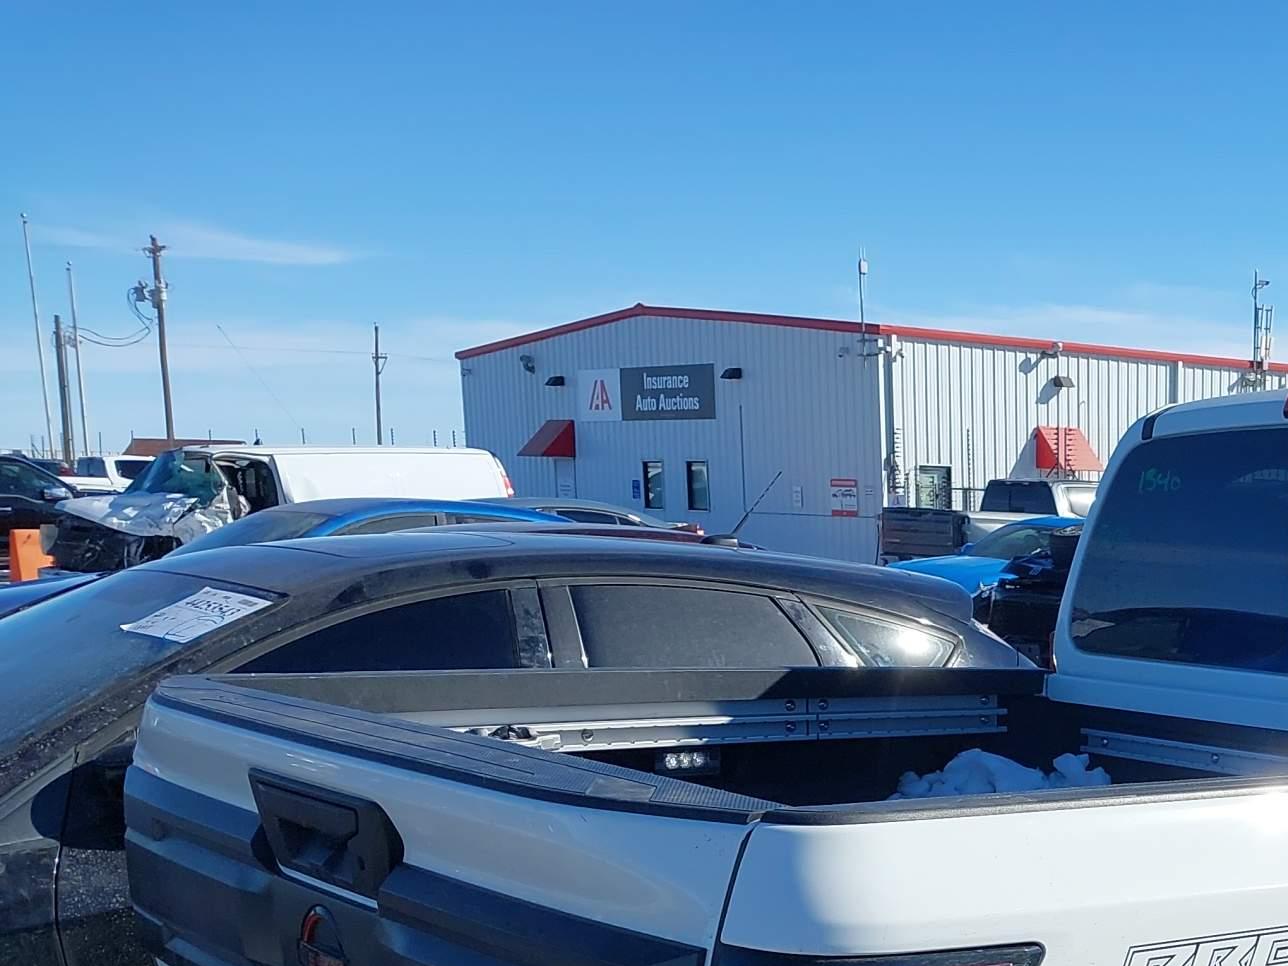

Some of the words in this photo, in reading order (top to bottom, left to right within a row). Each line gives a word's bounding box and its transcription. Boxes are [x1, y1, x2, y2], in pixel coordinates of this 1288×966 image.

[643, 372, 689, 390] Insurance
[635, 394, 657, 411] Auto
[658, 392, 700, 411] Auctions
